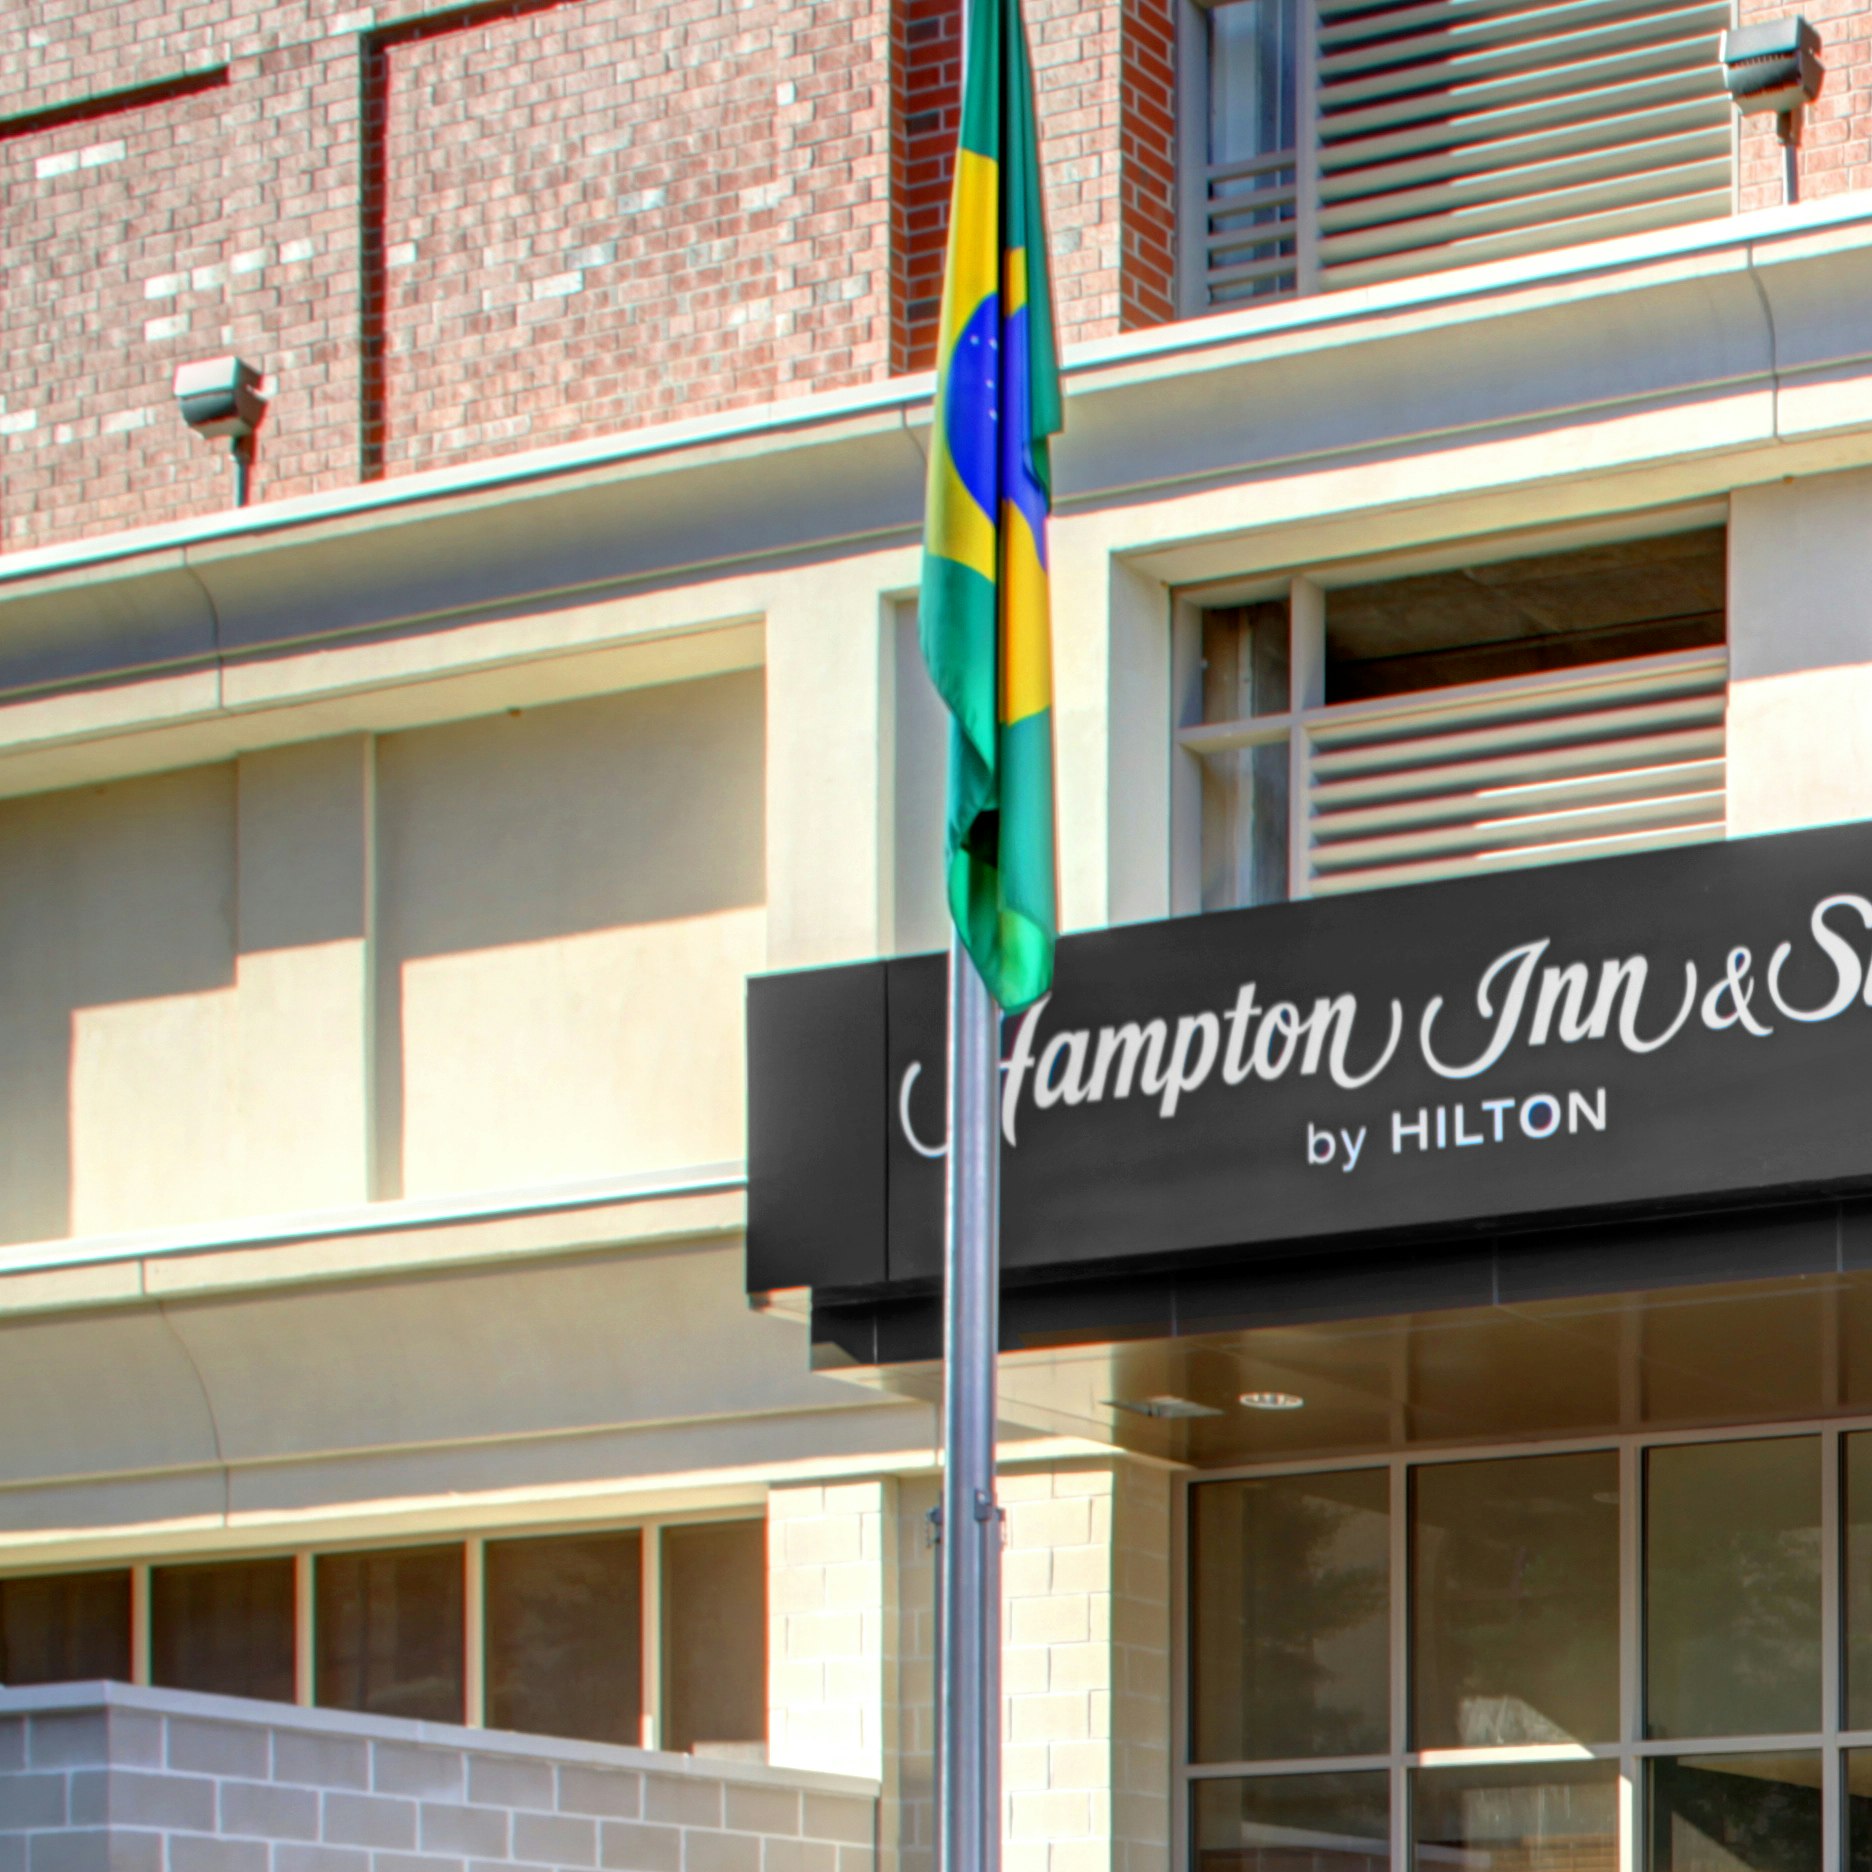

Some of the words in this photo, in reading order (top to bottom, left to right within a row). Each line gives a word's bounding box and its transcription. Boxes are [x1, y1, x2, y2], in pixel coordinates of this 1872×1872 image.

[1420, 938, 1697, 1079] Inn
[1700, 944, 1774, 1037] &
[1307, 1121, 1367, 1172] by
[1391, 1087, 1607, 1154] HILTON
